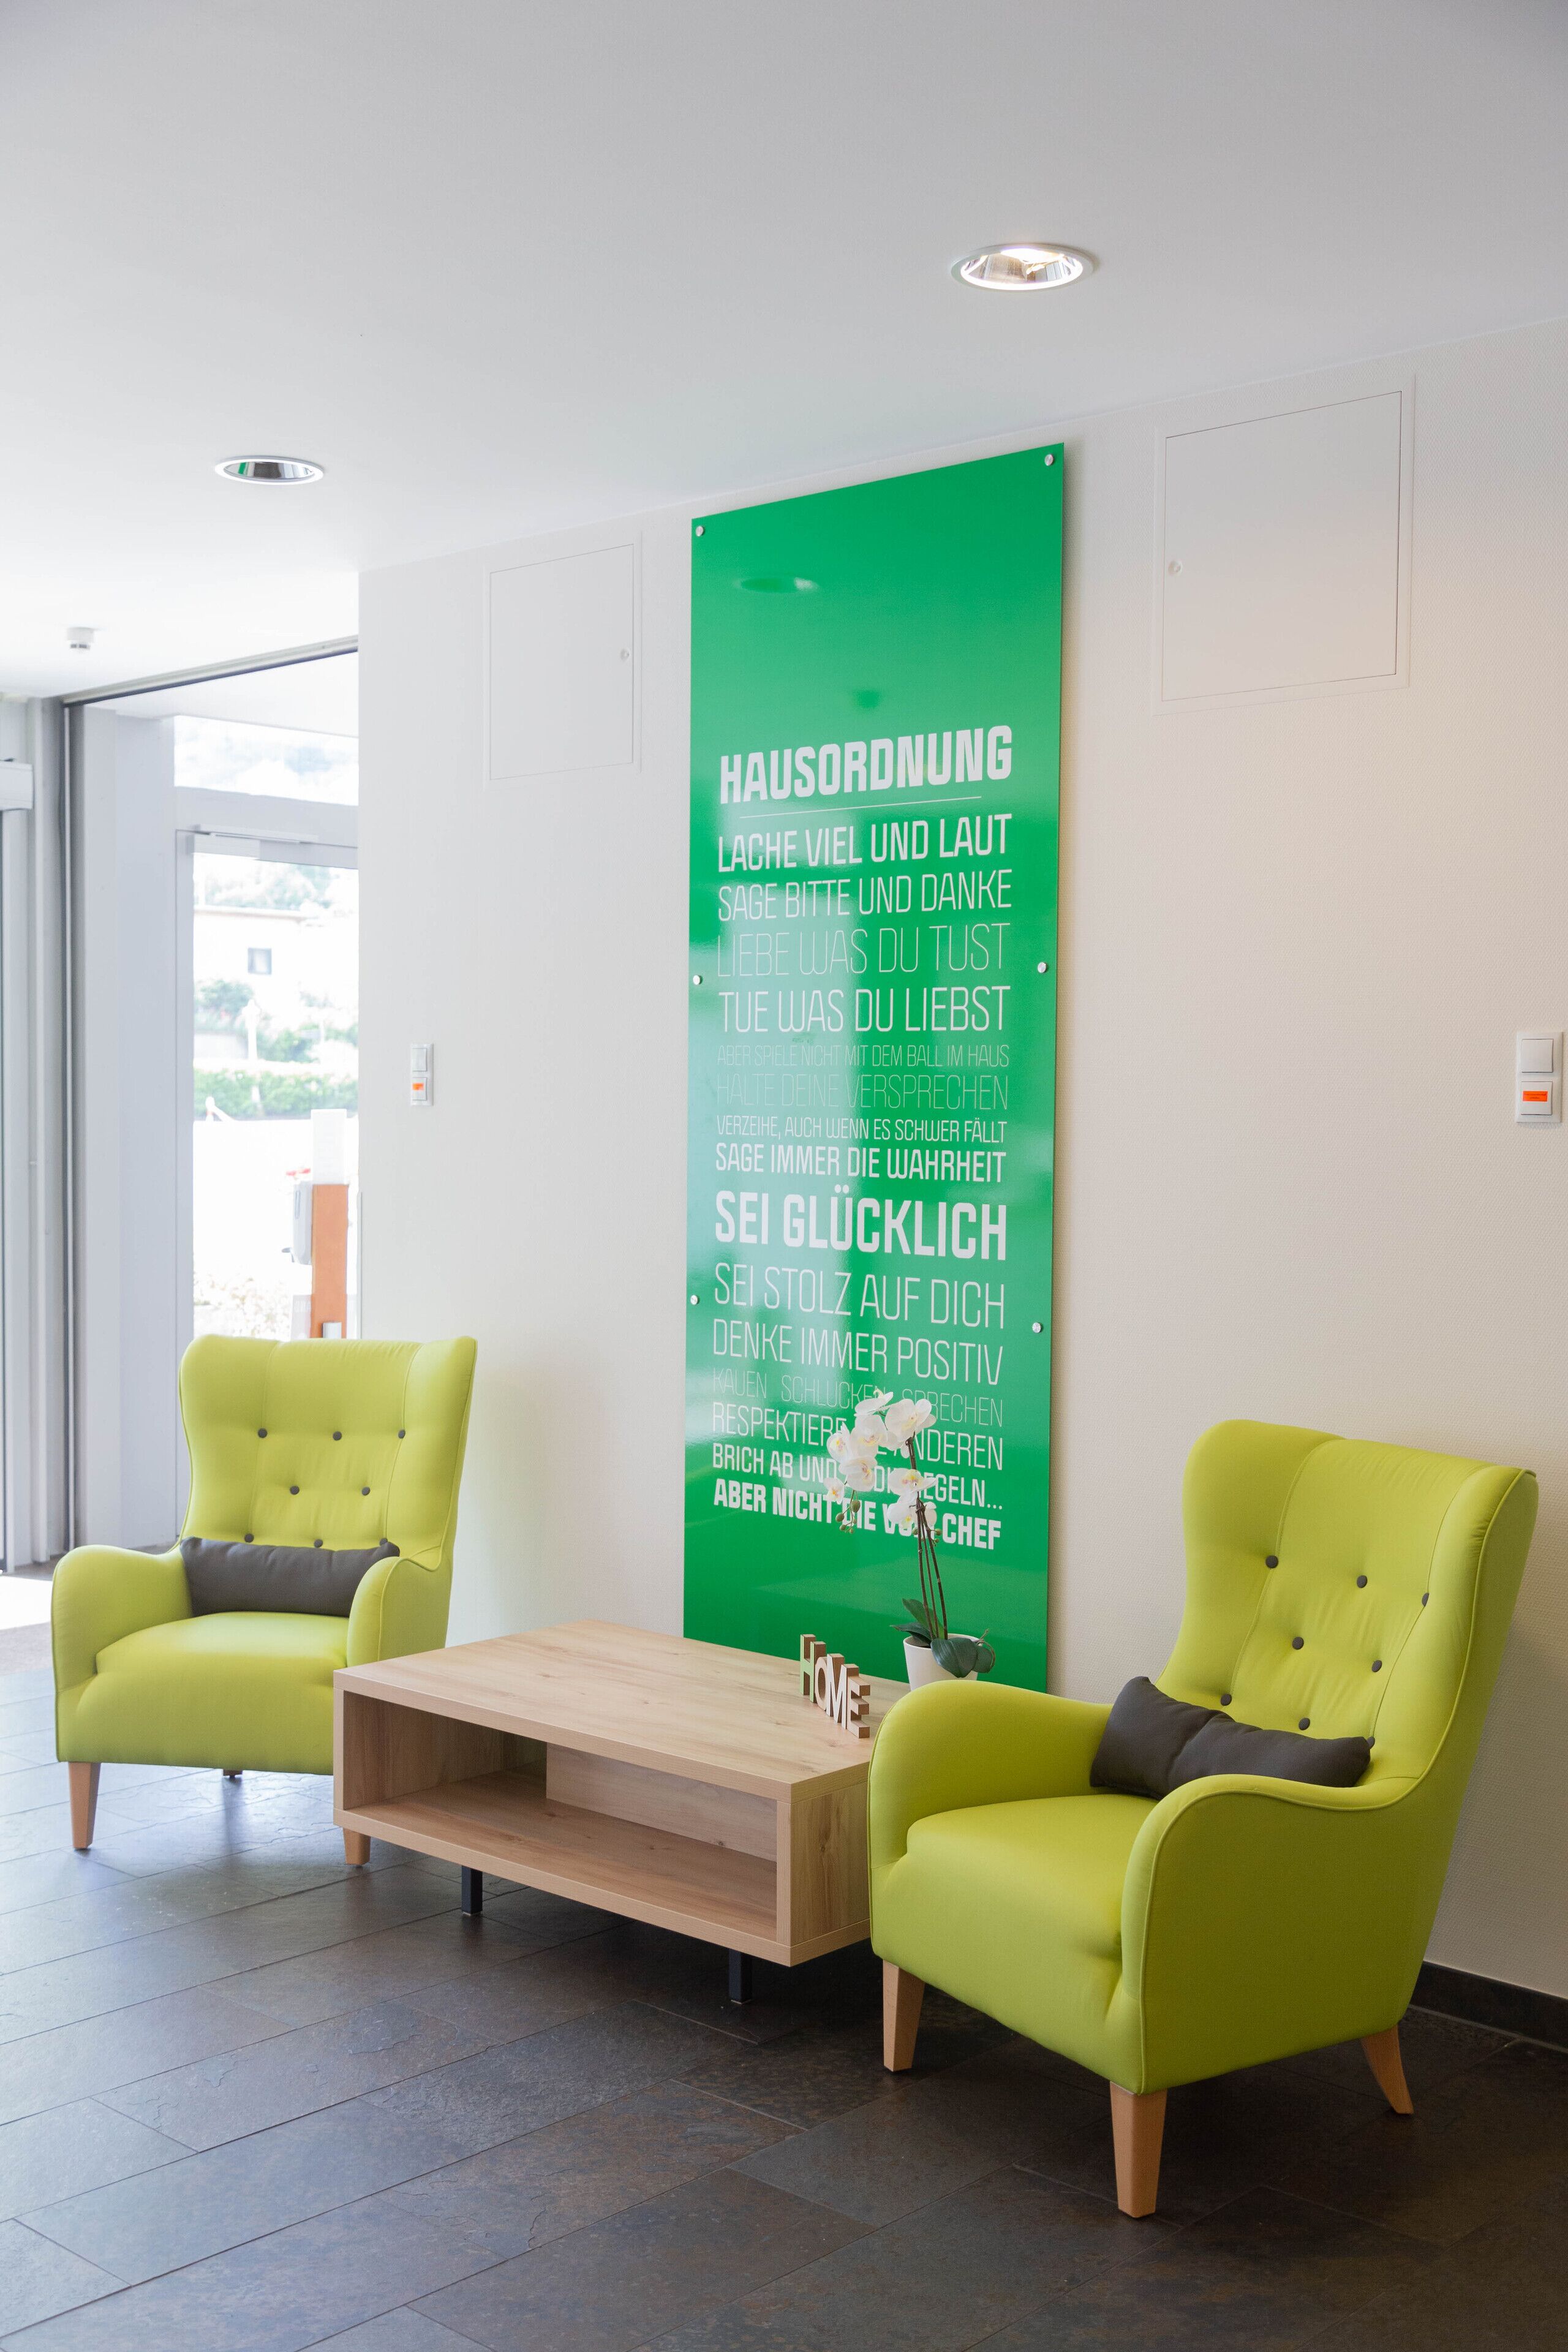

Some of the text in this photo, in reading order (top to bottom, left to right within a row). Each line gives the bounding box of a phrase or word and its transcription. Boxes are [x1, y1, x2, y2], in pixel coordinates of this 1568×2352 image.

[720, 725, 1012, 804] HAUSORDNUNG
[718, 813, 1012, 872] LACHE VIEL UND LAUT
[718, 869, 1012, 921] SAGE BITTE UND DANKE
[718, 923, 1011, 977] LIEBE WAS DU TUST
[718, 986, 1011, 1031] TUE WAS DU LIEBST
[717, 1044, 1009, 1067] ABER SPIELE NICHT MIT DEM BALL IM HAUS
[717, 1074, 1008, 1110] HALTE DEINE VERSPRECHEN
[717, 1115, 1008, 1144] VERZEIHE, AUCH WENN ES SCHWER FÄLLT
[716, 1142, 1006, 1183] SAGE IMMER DIE WAHRHEIT
[715, 1185, 1006, 1261] SEI GLÜCKLICH
[715, 1263, 1005, 1329] SEI STOLZ AUF DICH
[714, 1318, 1003, 1385] DENKE IMMER POSITIV
[713, 1368, 767, 1398] KAUEN
[894, 1428, 1003, 1470] NDEREN
[713, 1443, 764, 1476] BRICH
[769, 1452, 793, 1478] AB
[918, 1472, 1003, 1510] EGELN...
[714, 1479, 766, 1513] ABER
[772, 1488, 835, 1524] NICHT
[943, 1513, 1001, 1550] CHEF
[800, 1634, 870, 1738] HOME
